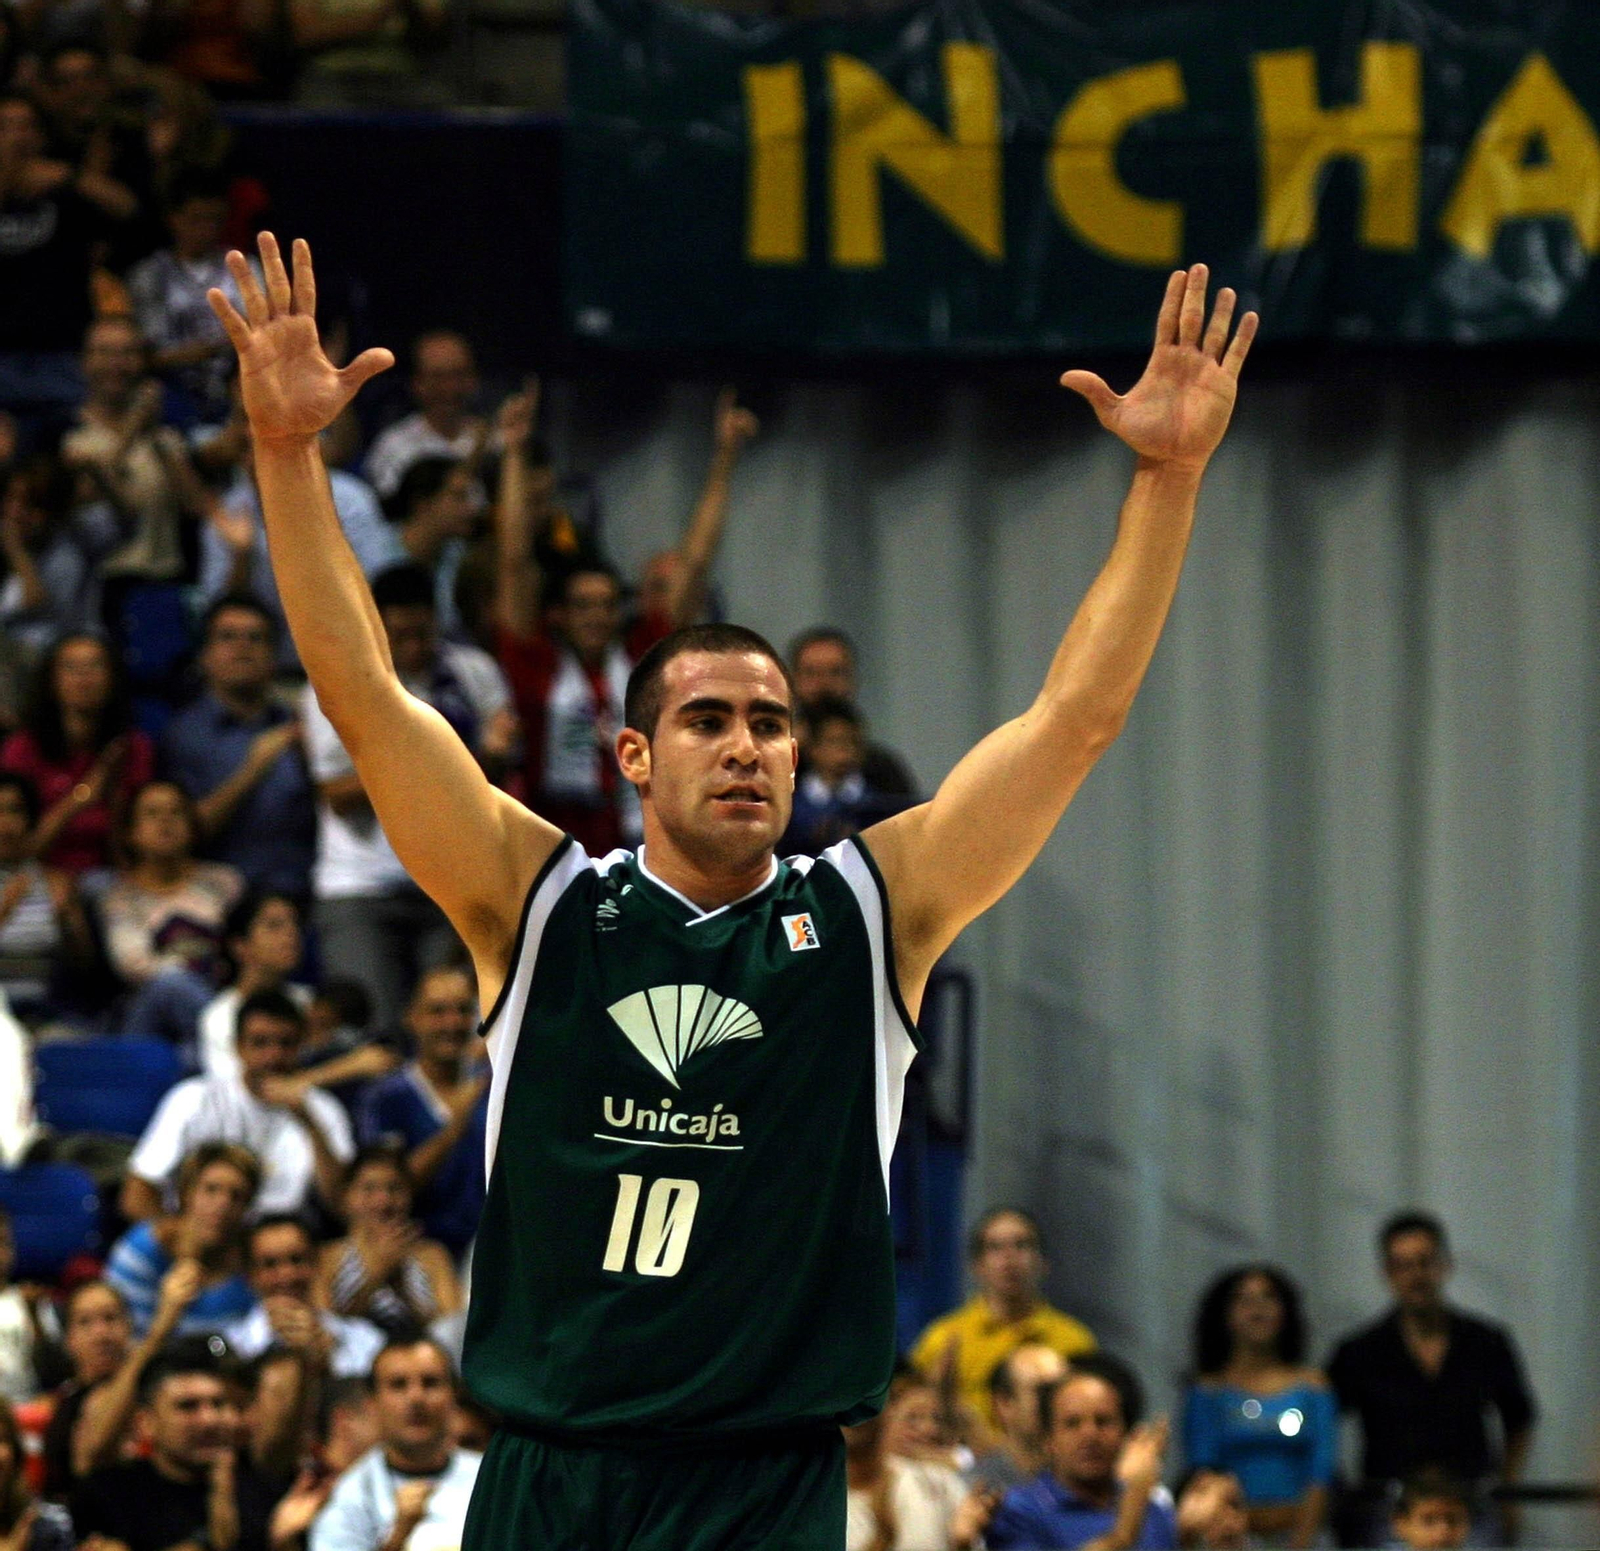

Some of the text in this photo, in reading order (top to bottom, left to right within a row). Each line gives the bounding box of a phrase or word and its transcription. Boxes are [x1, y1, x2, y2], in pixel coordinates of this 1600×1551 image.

[743, 41, 1600, 267] INCHA
[802, 920, 816, 946] ACB
[603, 1096, 741, 1143] Unicaja
[602, 1173, 700, 1277] 10
